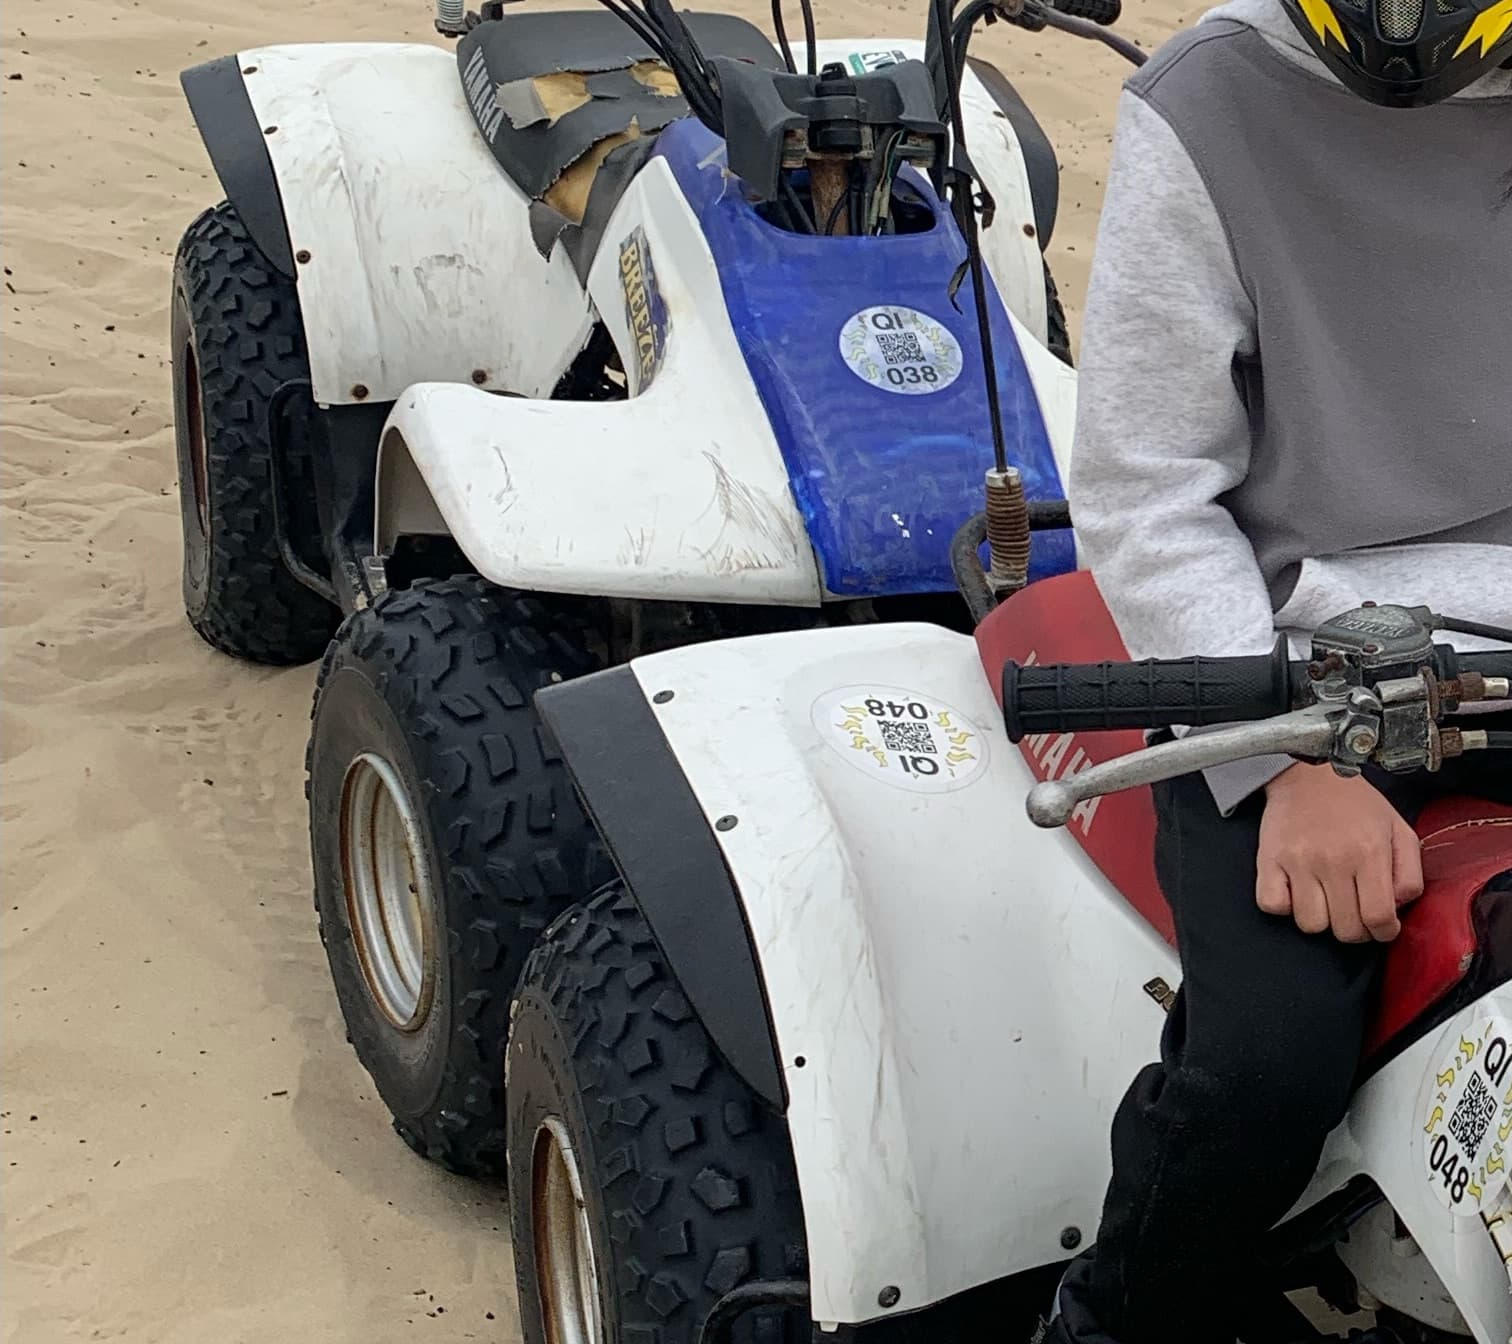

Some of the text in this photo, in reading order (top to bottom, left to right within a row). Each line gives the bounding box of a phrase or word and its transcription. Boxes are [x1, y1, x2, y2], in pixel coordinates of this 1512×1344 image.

[463, 45, 504, 144] YAMAHA
[871, 312, 904, 330] QI
[886, 365, 939, 385] 038
[864, 699, 929, 719] 048
[899, 755, 940, 775] QI
[1430, 1135, 1469, 1204] 048
